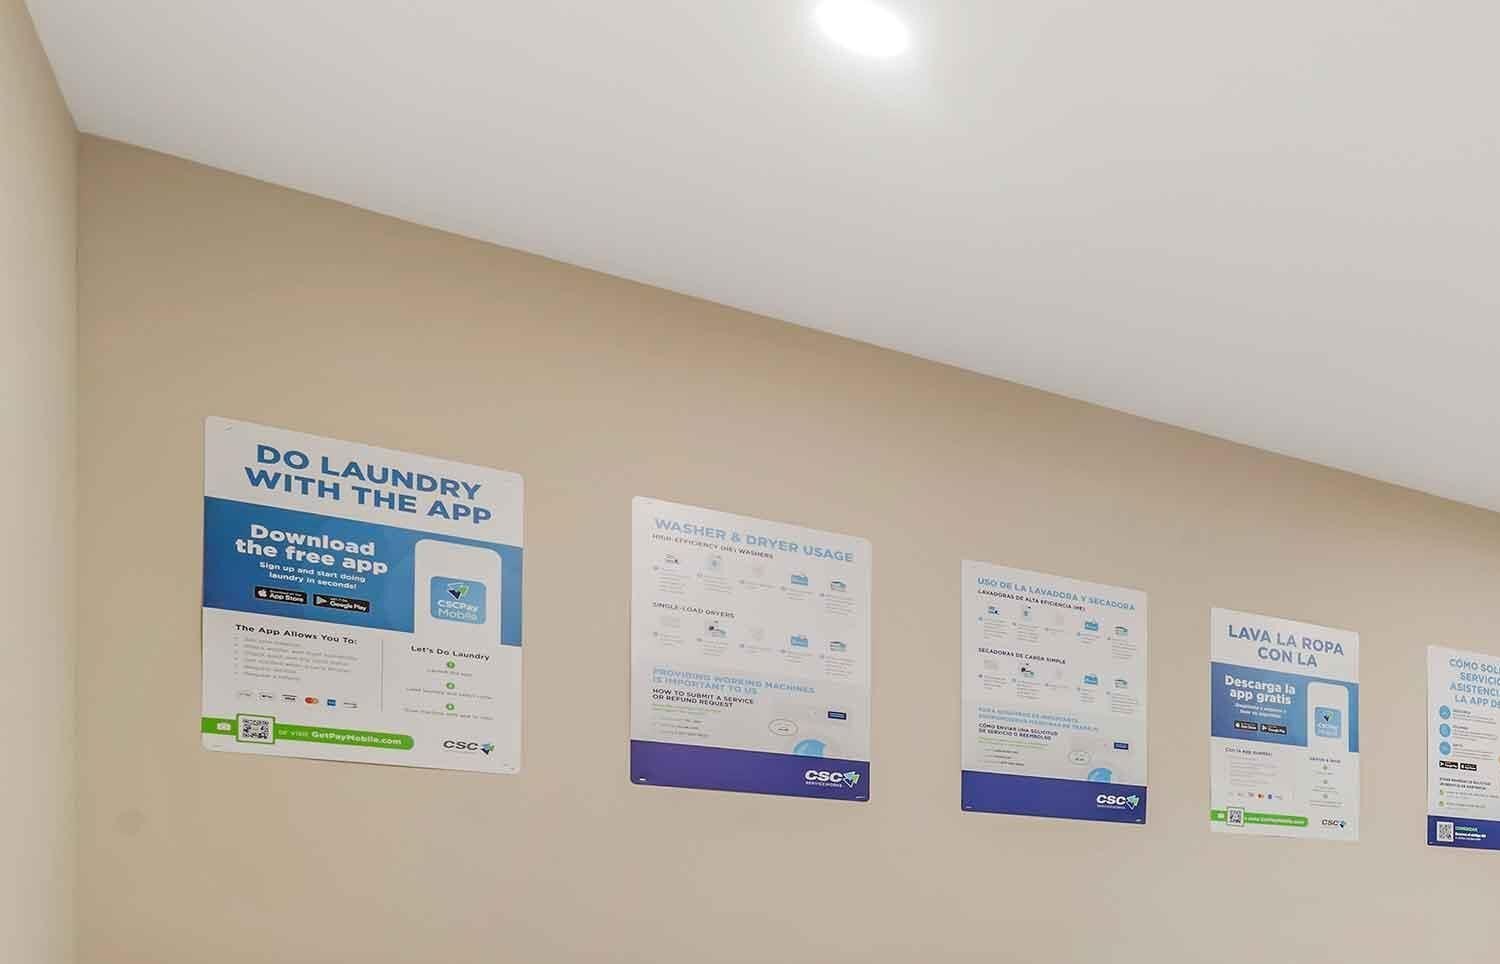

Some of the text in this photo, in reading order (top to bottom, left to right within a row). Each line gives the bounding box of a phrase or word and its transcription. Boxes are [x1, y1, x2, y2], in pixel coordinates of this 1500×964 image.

[256, 444, 481, 500] DO LAUNDRY
[244, 467, 492, 524] WITH THE APP
[250, 524, 375, 556] Download
[655, 518, 854, 563] WASHER & DRYER USAGE
[235, 538, 388, 575] the free app
[259, 561, 365, 583] Sign up and start doing
[269, 571, 357, 590] laundry in seconds!
[977, 577, 997, 587] USO
[1000, 582, 1013, 590] DE
[1014, 584, 1027, 592] LA
[1029, 585, 1078, 601] LAVADORA
[1089, 597, 1136, 611] SECADORA
[235, 624, 358, 645] The App Allows You To:
[1228, 624, 1344, 656] LAVA LA ROPA
[411, 645, 434, 654] Let's
[452, 651, 490, 661] Laundry
[1258, 646, 1317, 667] CON LA
[1225, 674, 1296, 694] Descarga la
[652, 688, 672, 696] HOW
[725, 695, 754, 705] SERVICE
[699, 698, 733, 707] REQUEST
[1230, 689, 1291, 705] app gratis
[1454, 695, 1468, 704] LA
[443, 739, 479, 752] CSC
[805, 770, 843, 783] CSC
[1096, 794, 1126, 805] CSC
